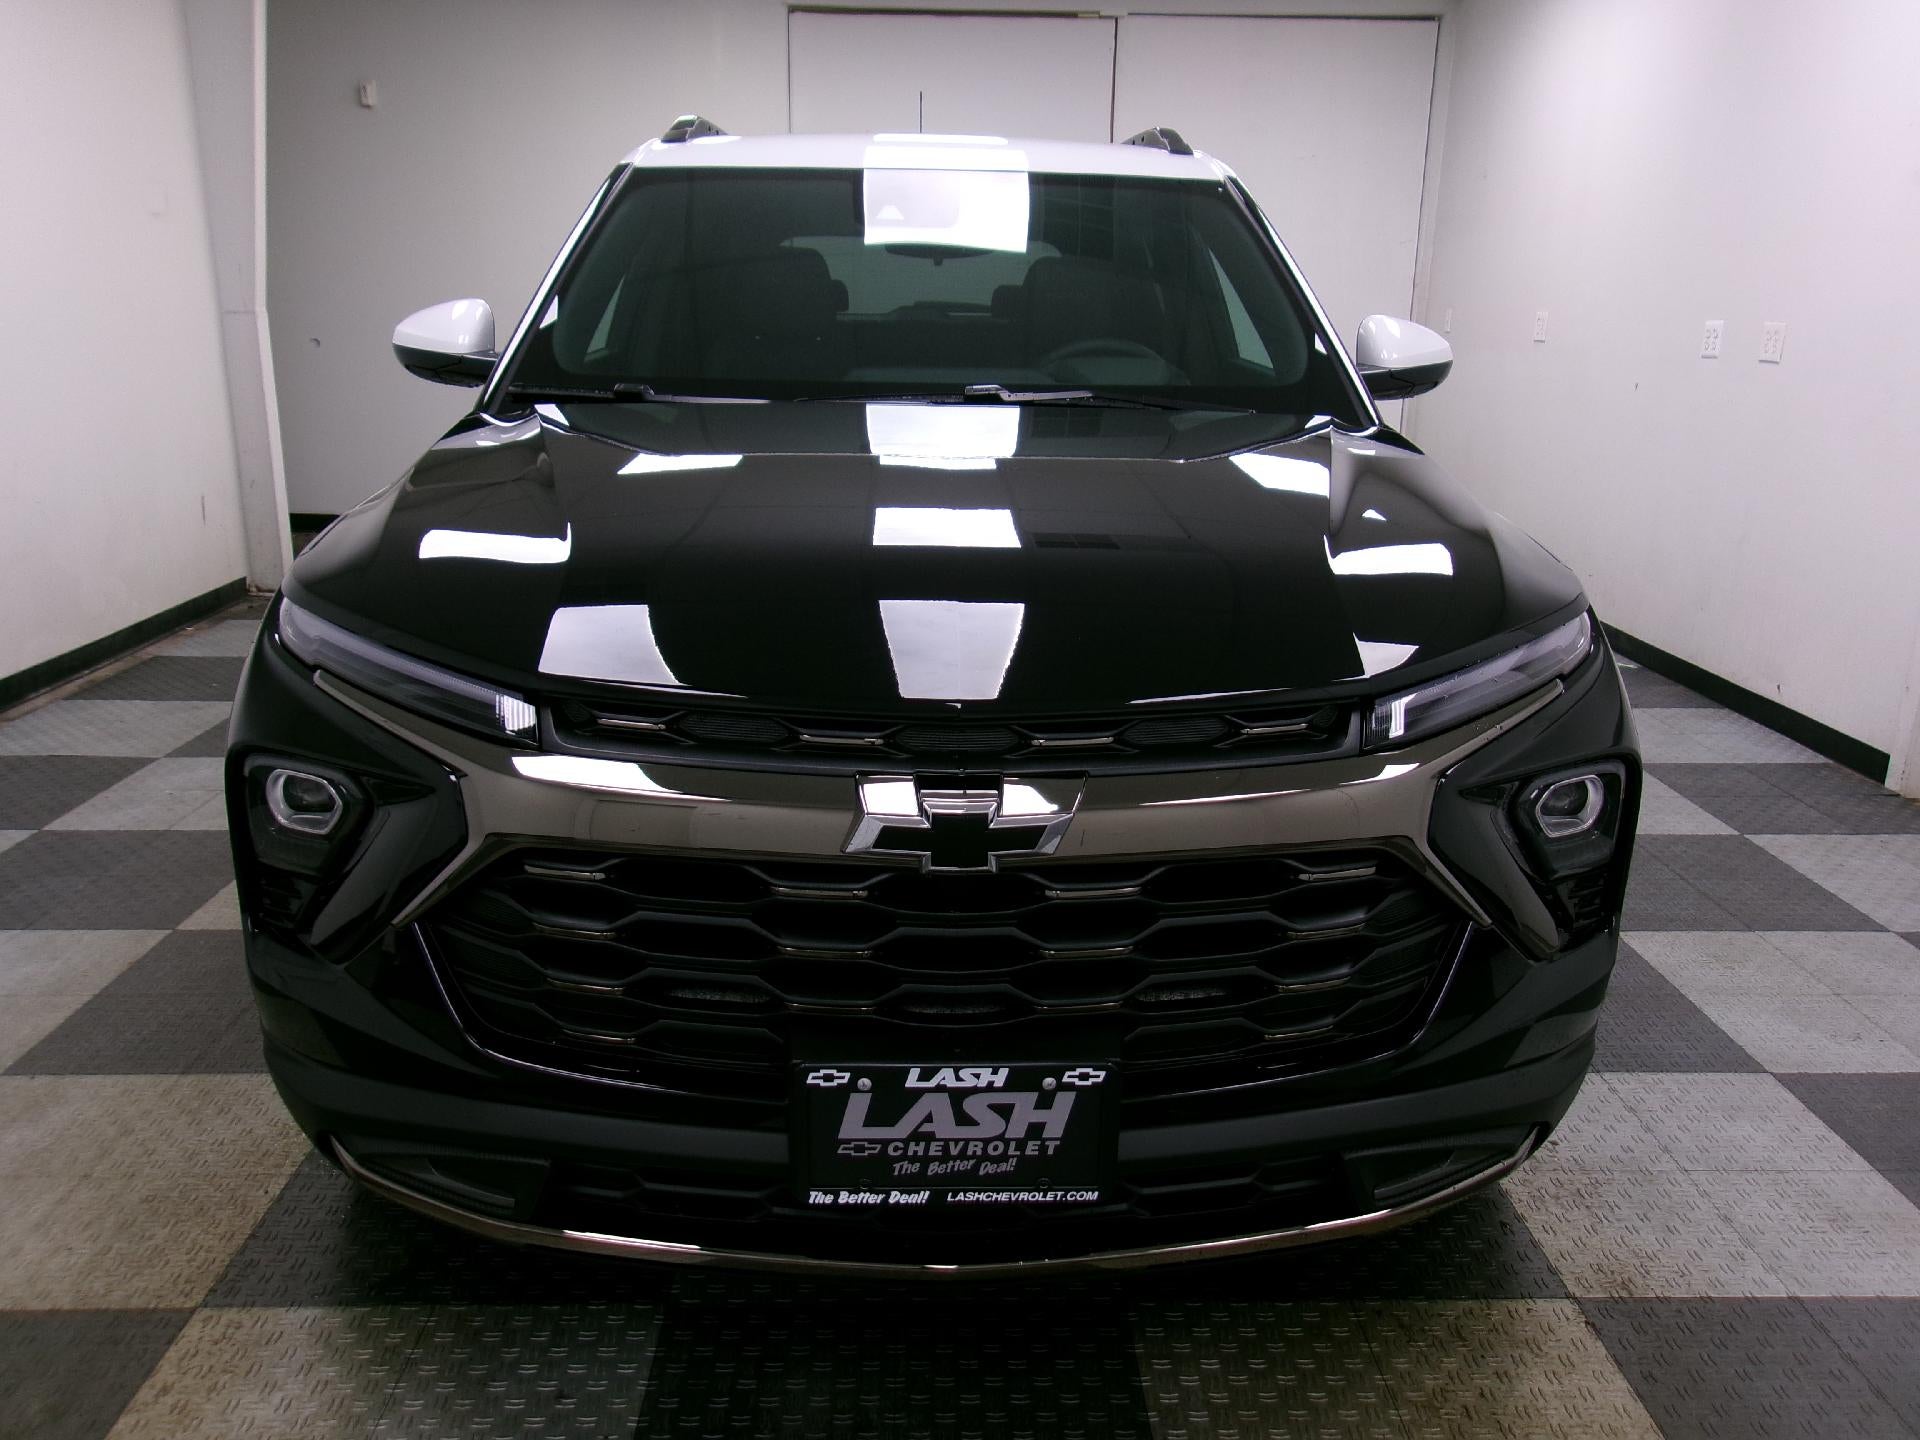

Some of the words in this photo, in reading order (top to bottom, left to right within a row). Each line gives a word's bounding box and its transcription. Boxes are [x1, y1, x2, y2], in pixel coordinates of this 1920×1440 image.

[905, 1068, 1009, 1087] LASH
[838, 1091, 1077, 1139] LASH
[887, 1141, 1061, 1156] CHEVROLET
[893, 1161, 920, 1176] The
[927, 1159, 976, 1176] Better
[979, 1157, 1016, 1175] Deal!
[809, 1191, 836, 1204] The
[838, 1191, 885, 1204] Better
[888, 1190, 930, 1204] Deal!
[947, 1191, 1099, 1202] LASHCHEVROLET.COM
